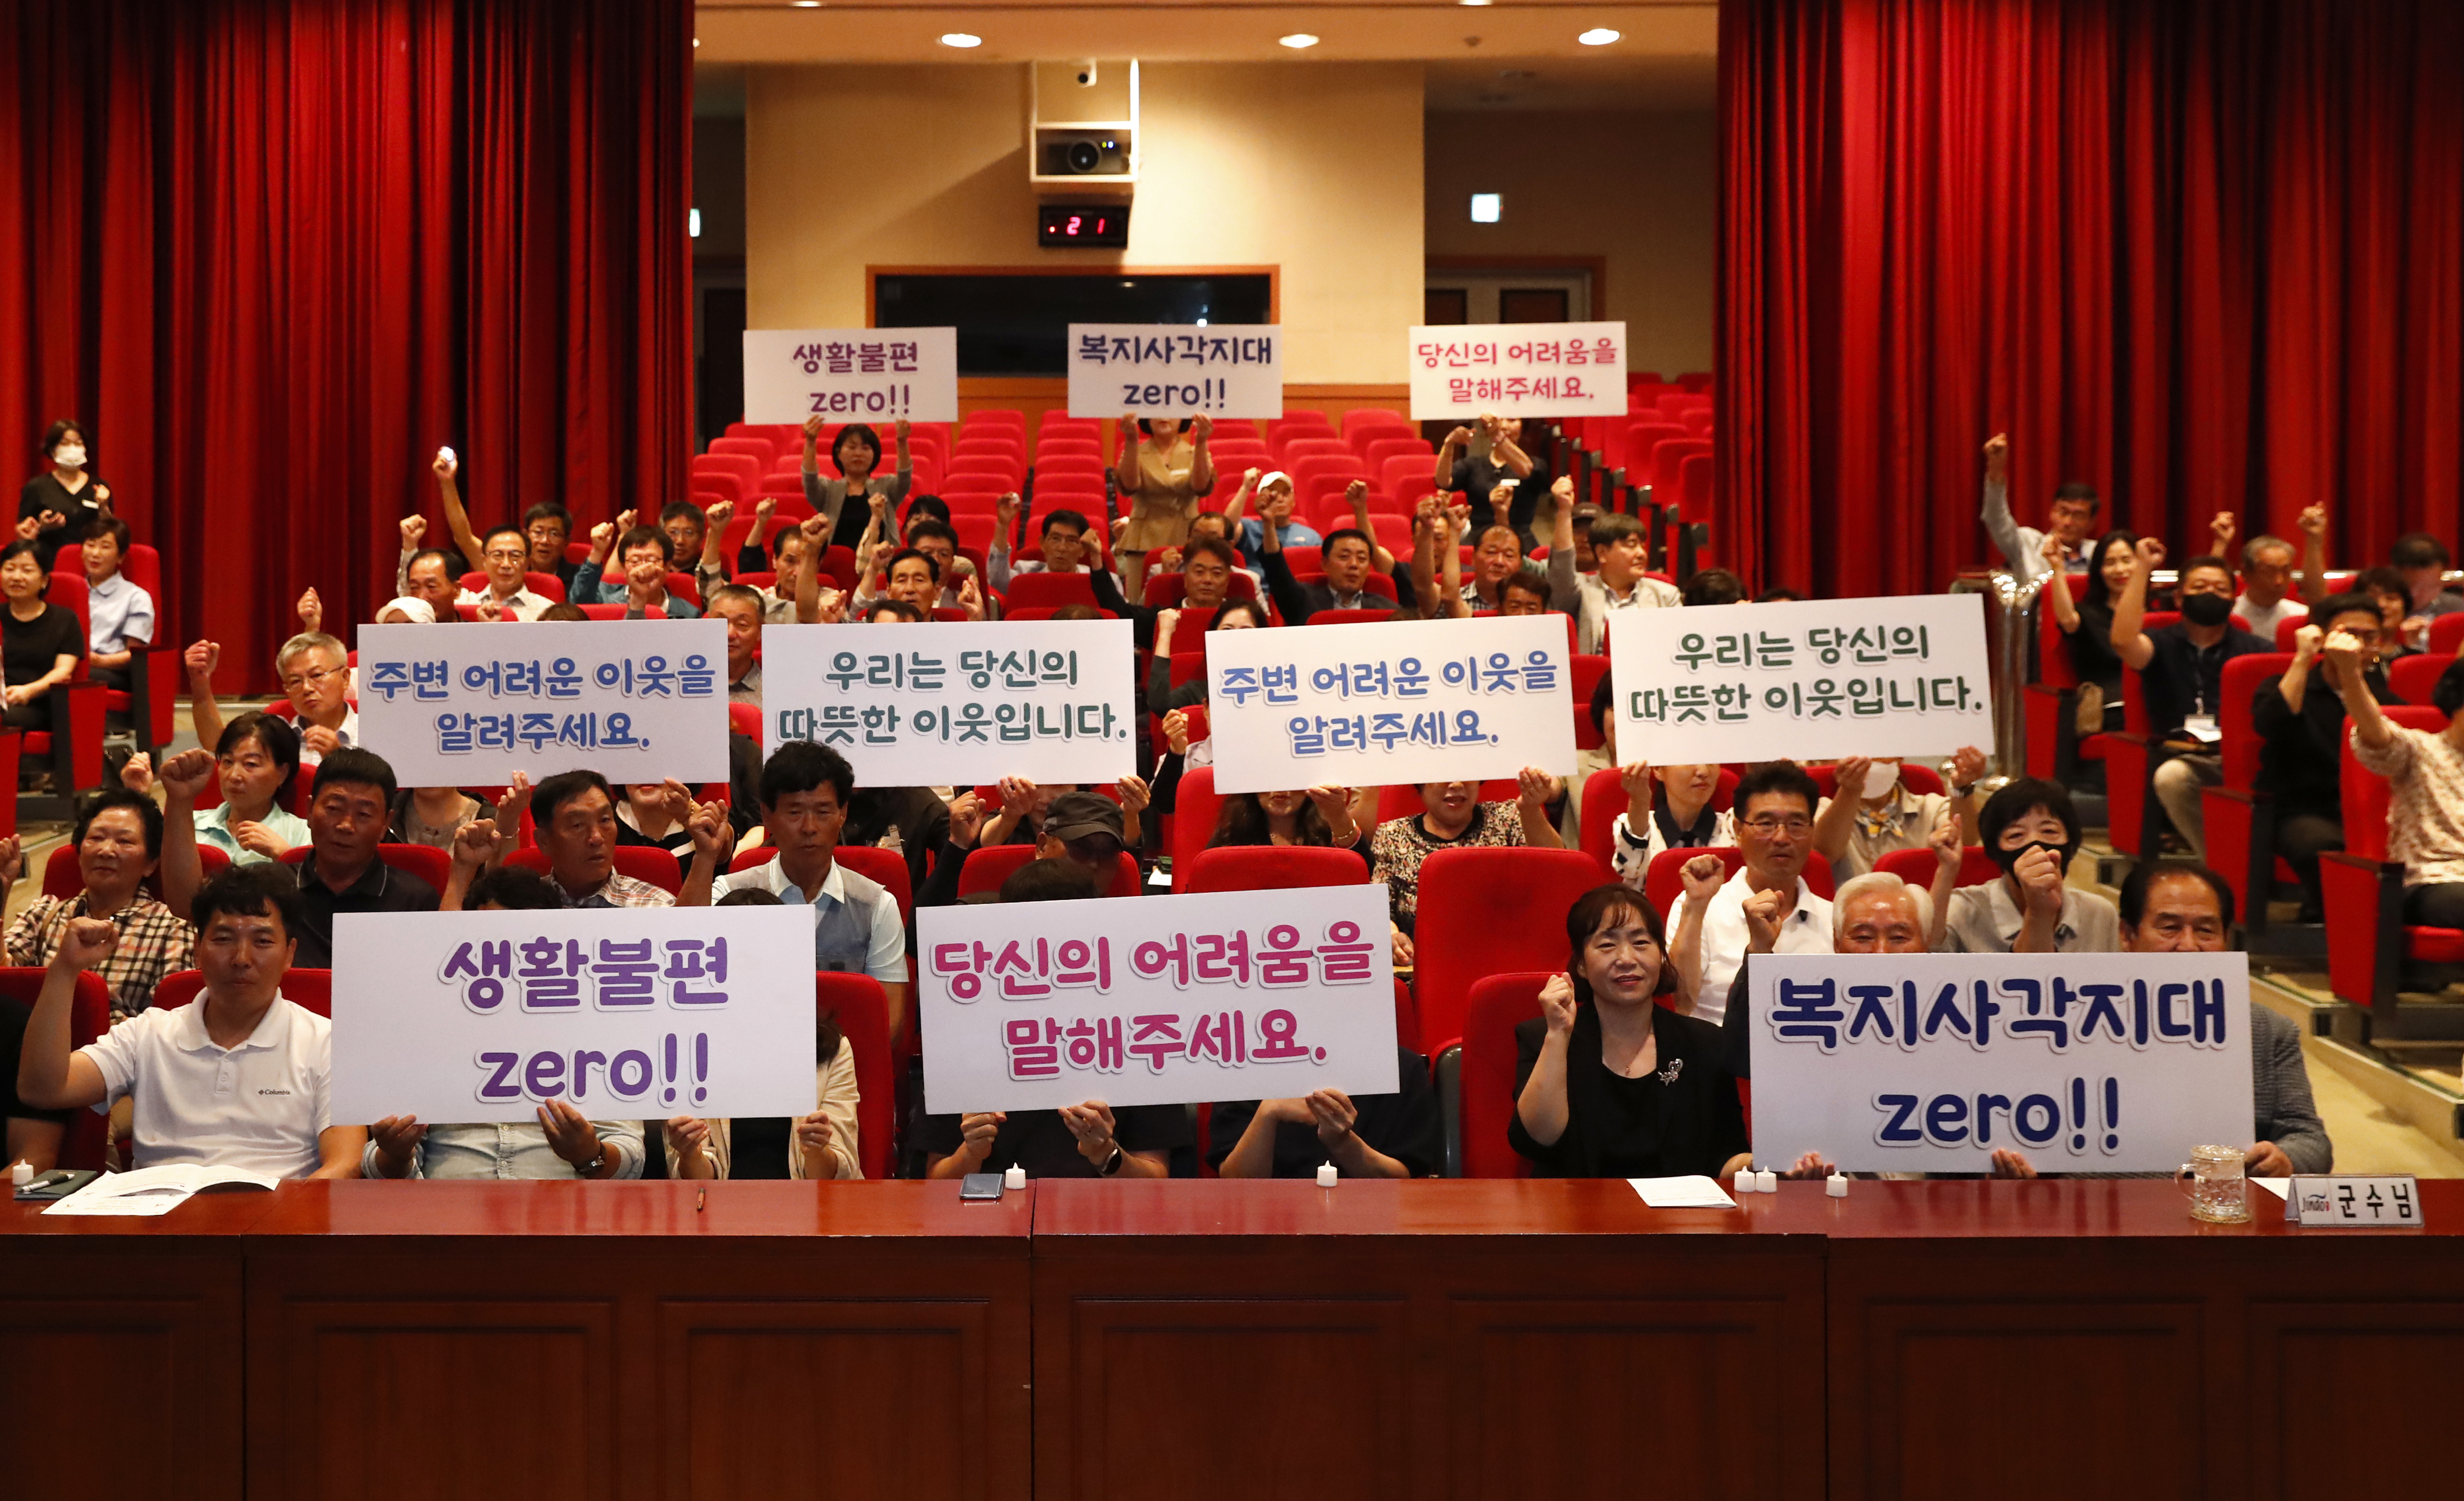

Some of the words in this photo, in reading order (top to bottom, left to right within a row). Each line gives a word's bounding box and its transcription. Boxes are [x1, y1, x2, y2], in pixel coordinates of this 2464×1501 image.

[793, 342, 917, 374] 생활불편
[1079, 335, 1270, 365] 복지사각지대
[1418, 343, 1497, 367] 당신의
[1509, 338, 1617, 365] 어려움을
[810, 384, 909, 414] zero!!
[1124, 379, 1225, 408] zero!!
[1450, 377, 1594, 402] 말해주세요.
[1675, 631, 1794, 670] 우리는
[1809, 625, 1928, 664] 당신의
[372, 661, 448, 698] 주변
[464, 658, 583, 696] 어려운
[596, 655, 715, 695] 이웃을
[826, 652, 946, 690] 우리는
[961, 650, 1077, 688] 당신의
[1221, 664, 1298, 704] 주변
[1313, 658, 1429, 697] 어려운
[1443, 651, 1557, 691] 이웃을
[1631, 683, 1751, 722] 따뜻한
[1765, 676, 1982, 716] 이웃입니다.
[438, 713, 650, 751] 알려주세요.
[780, 705, 900, 744] 따뜻한
[914, 703, 1126, 742] 이웃입니다.
[1290, 710, 1498, 754] 알려주세요.
[444, 936, 729, 1009] 생활불편
[935, 936, 1110, 999] 당신의
[1134, 921, 1374, 986] 어려움을
[1772, 977, 2226, 1048] 복지사각지대
[1007, 1009, 1327, 1076] 말해주세요.
[480, 1033, 708, 1102] zero!!
[1878, 1077, 2118, 1150] zero!!
